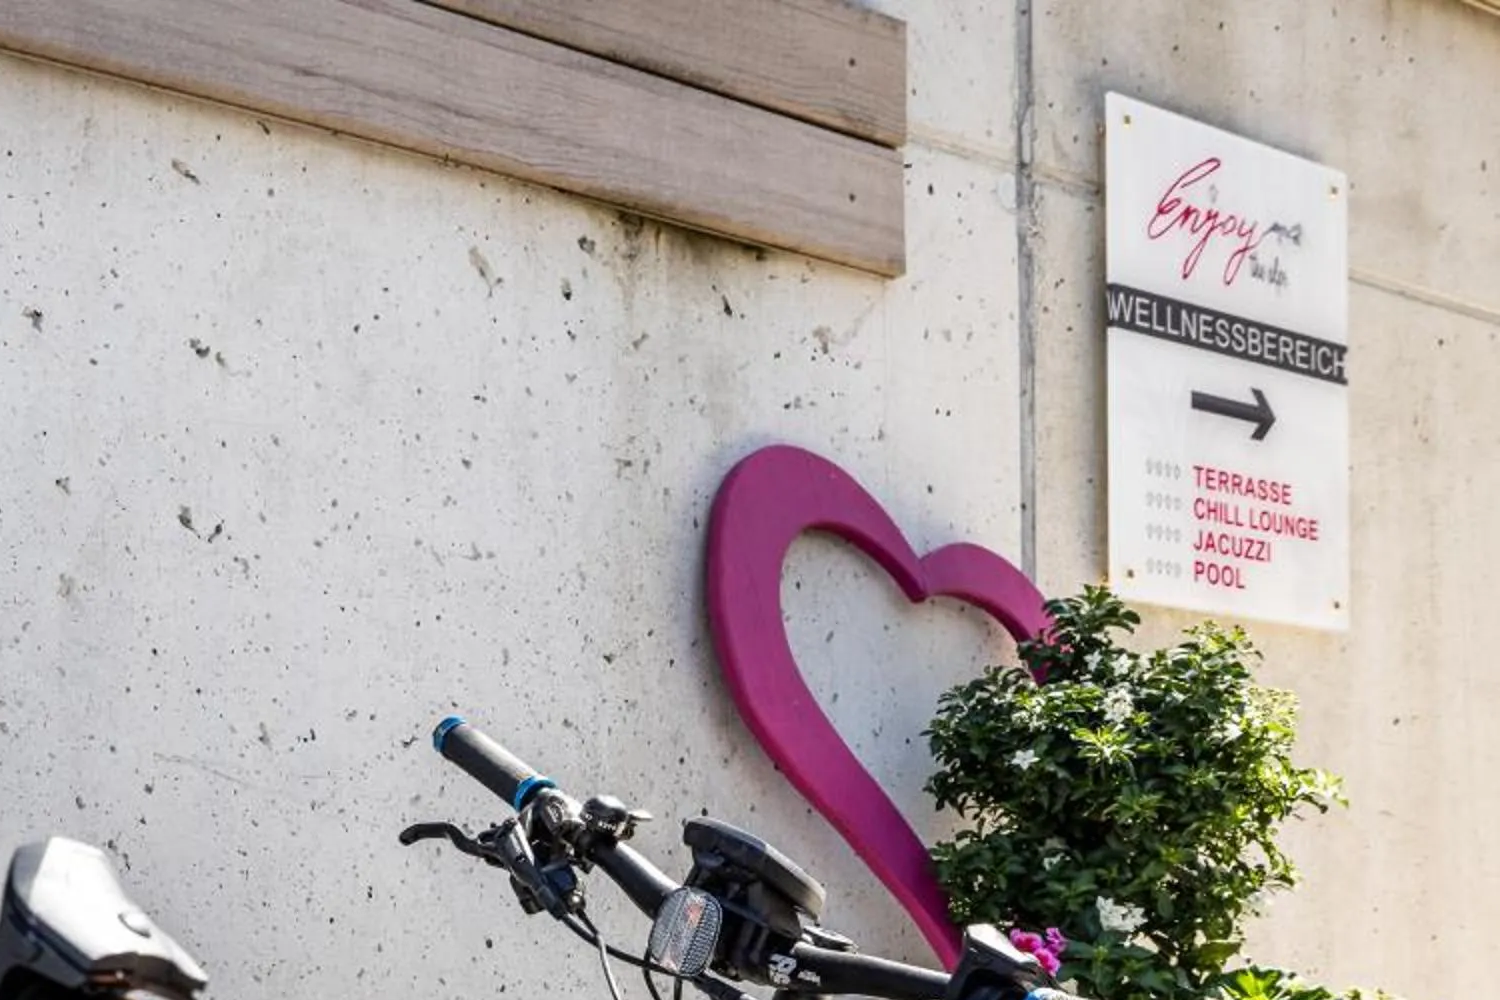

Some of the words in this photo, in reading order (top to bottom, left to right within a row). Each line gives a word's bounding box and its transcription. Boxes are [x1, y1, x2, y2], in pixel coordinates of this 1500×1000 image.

[1148, 157, 1258, 286] Enjoy
[1107, 290, 1347, 377] WELLNESSBEREICH
[1193, 465, 1292, 505] TERRASSE
[1193, 497, 1244, 527] CHILL
[1250, 508, 1319, 540] LOUNGE
[1193, 530, 1272, 562] JACUZZI
[1193, 560, 1246, 589] POOL
